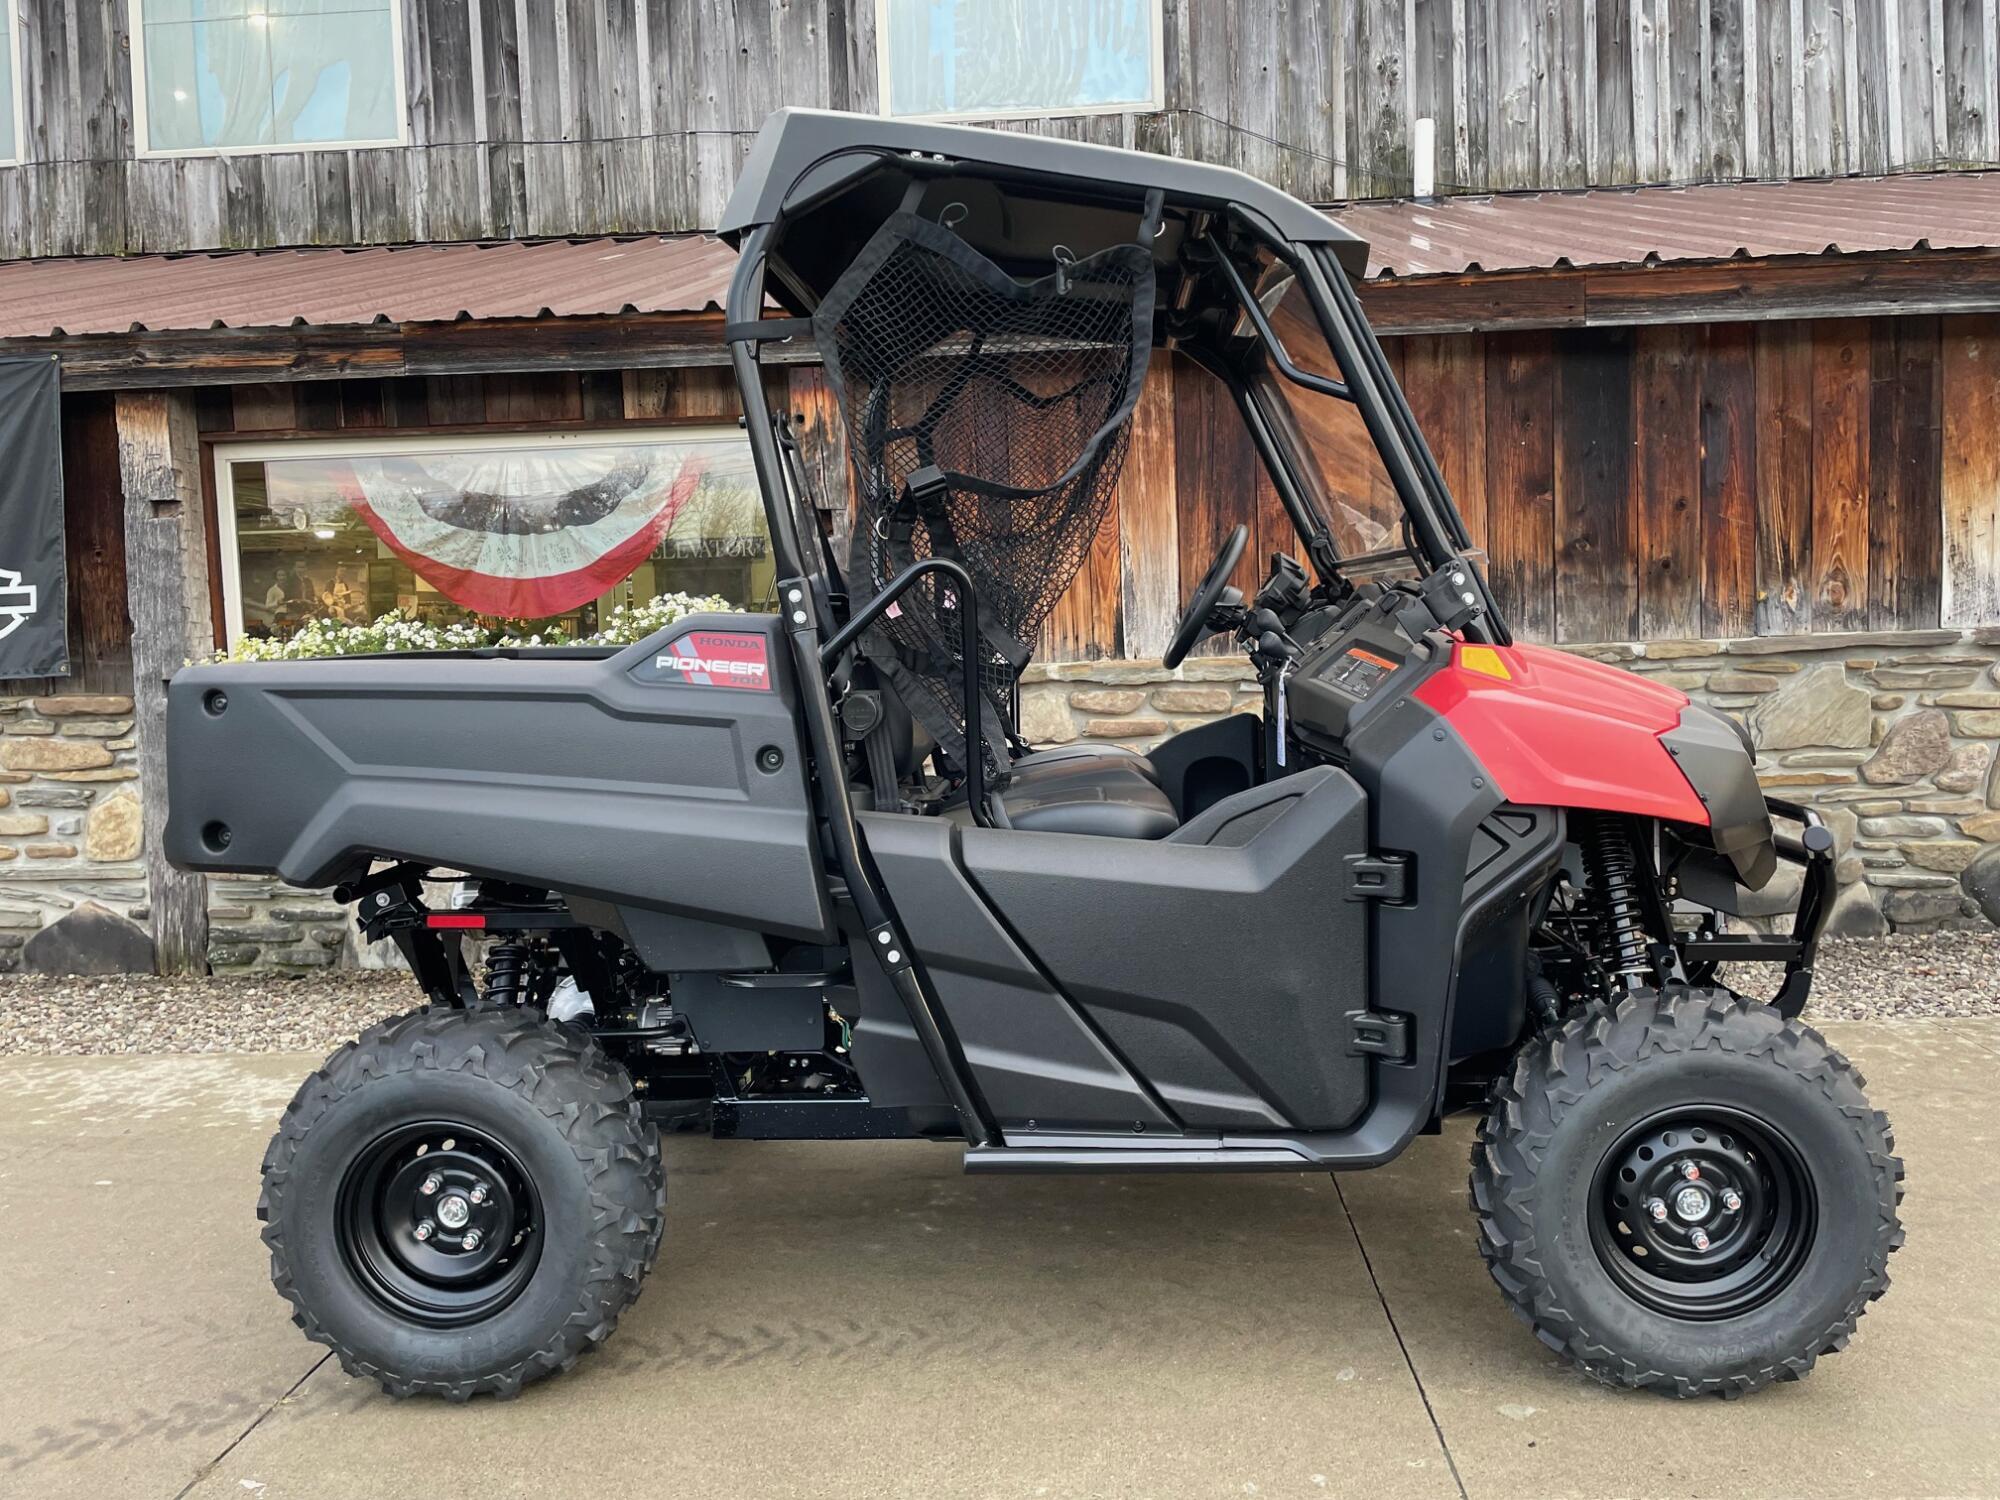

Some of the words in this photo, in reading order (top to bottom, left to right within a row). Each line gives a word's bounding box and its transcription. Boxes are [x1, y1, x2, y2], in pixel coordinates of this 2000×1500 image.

[649, 537, 757, 560] ELEVATOR
[700, 637, 760, 649] HONDA
[656, 656, 765, 676] PIONEER
